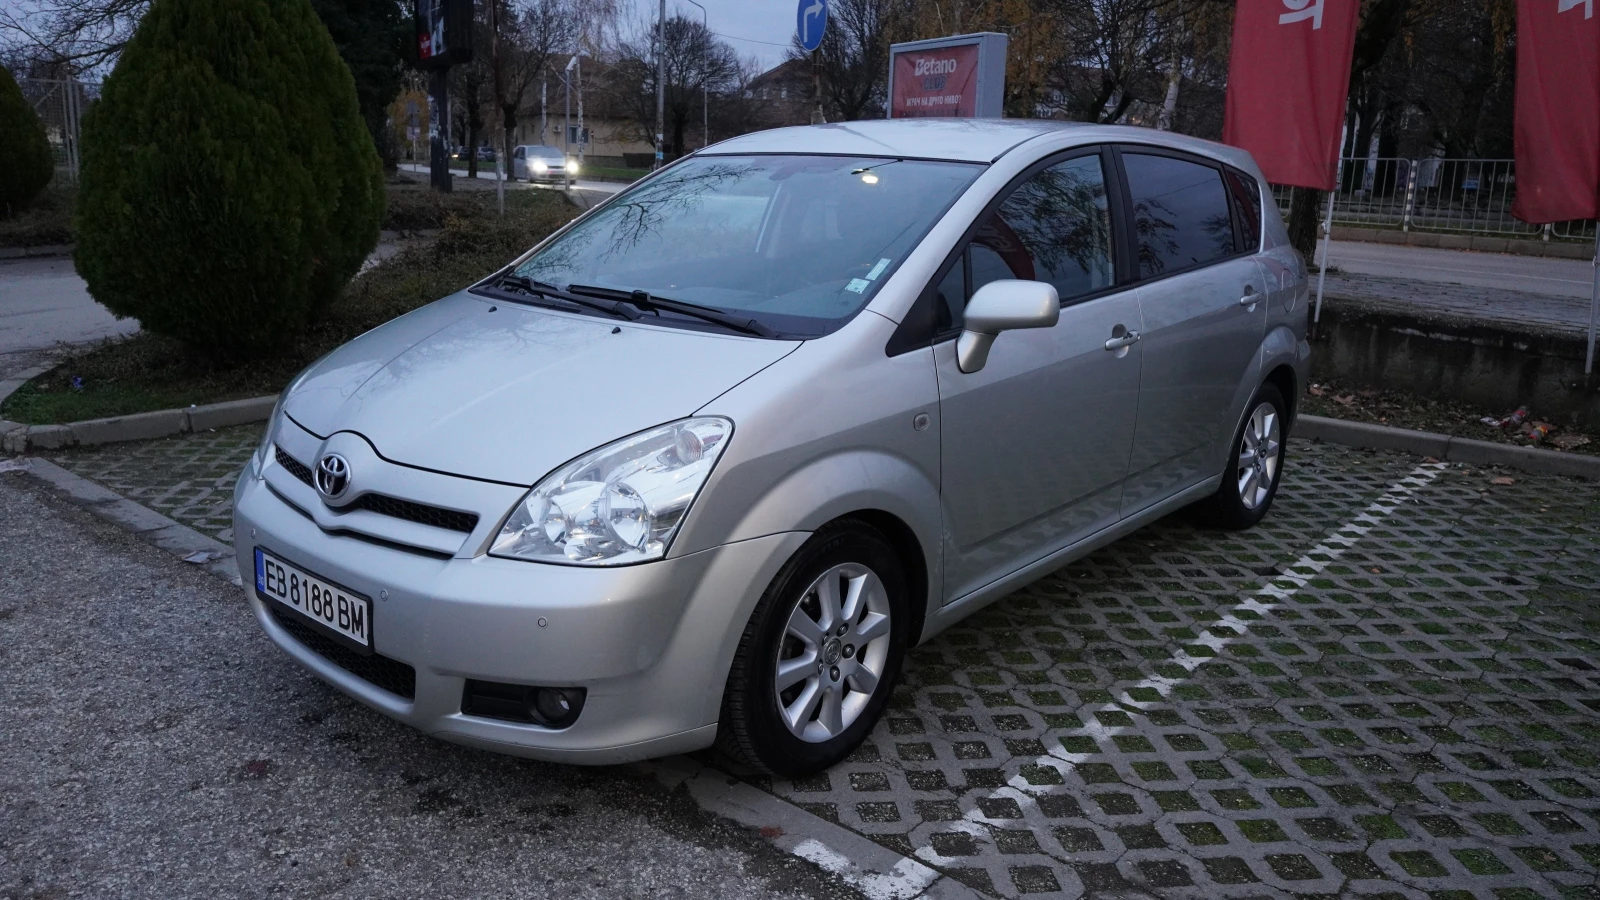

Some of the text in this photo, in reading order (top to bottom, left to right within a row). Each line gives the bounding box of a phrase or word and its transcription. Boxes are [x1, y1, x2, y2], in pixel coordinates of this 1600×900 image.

[915, 59, 956, 76] Betano
[921, 97, 928, 105] НА
[929, 96, 943, 106] ДРУГО
[945, 95, 962, 104] НИВО?
[265, 559, 364, 639] EB 8188 BM
